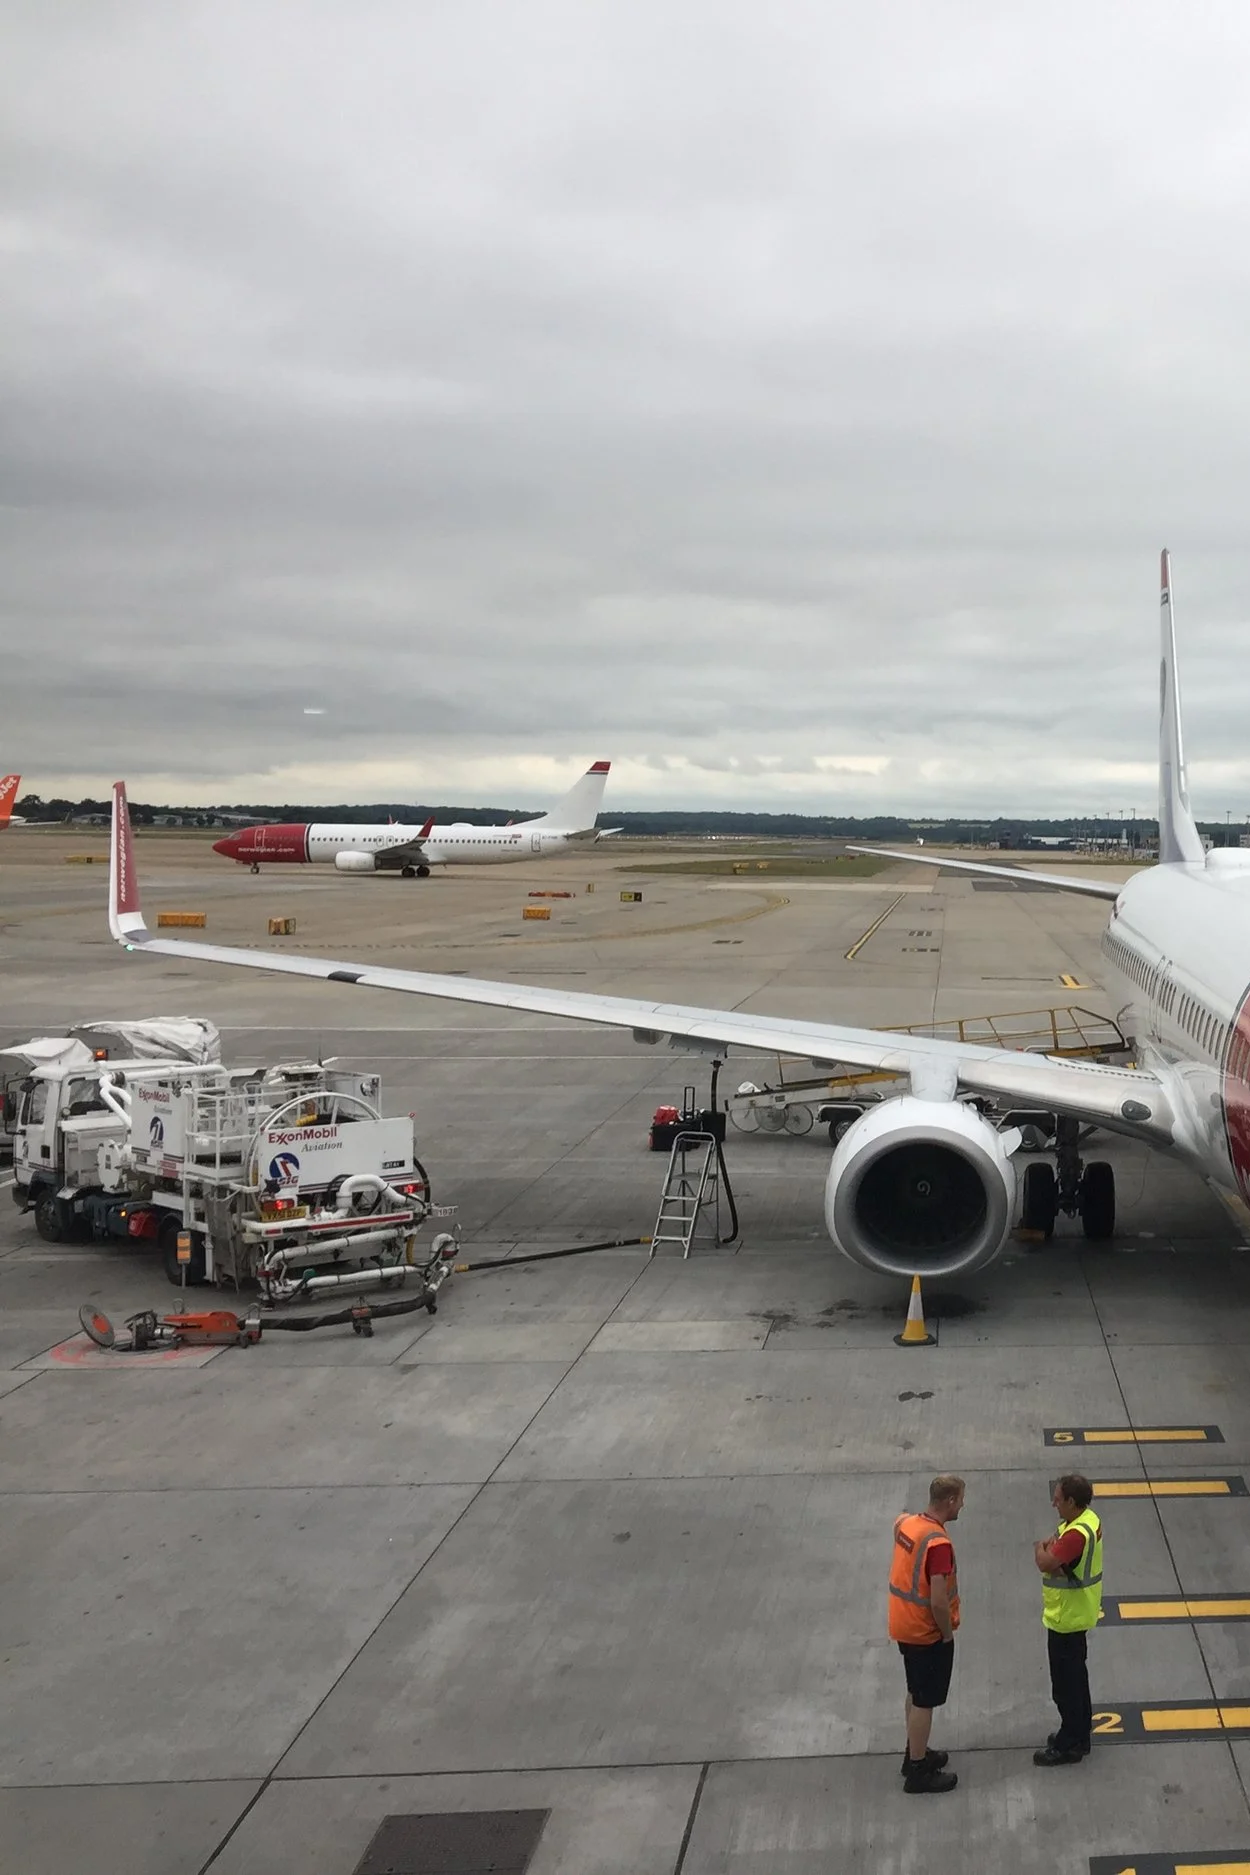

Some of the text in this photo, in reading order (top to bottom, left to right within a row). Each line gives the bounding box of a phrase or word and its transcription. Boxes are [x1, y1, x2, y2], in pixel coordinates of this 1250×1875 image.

[268, 1127, 338, 1145] ExxonMobil
[301, 1140, 343, 1152] Aviation
[1053, 1431, 1074, 1443] 5
[1091, 1712, 1125, 1733] 2
